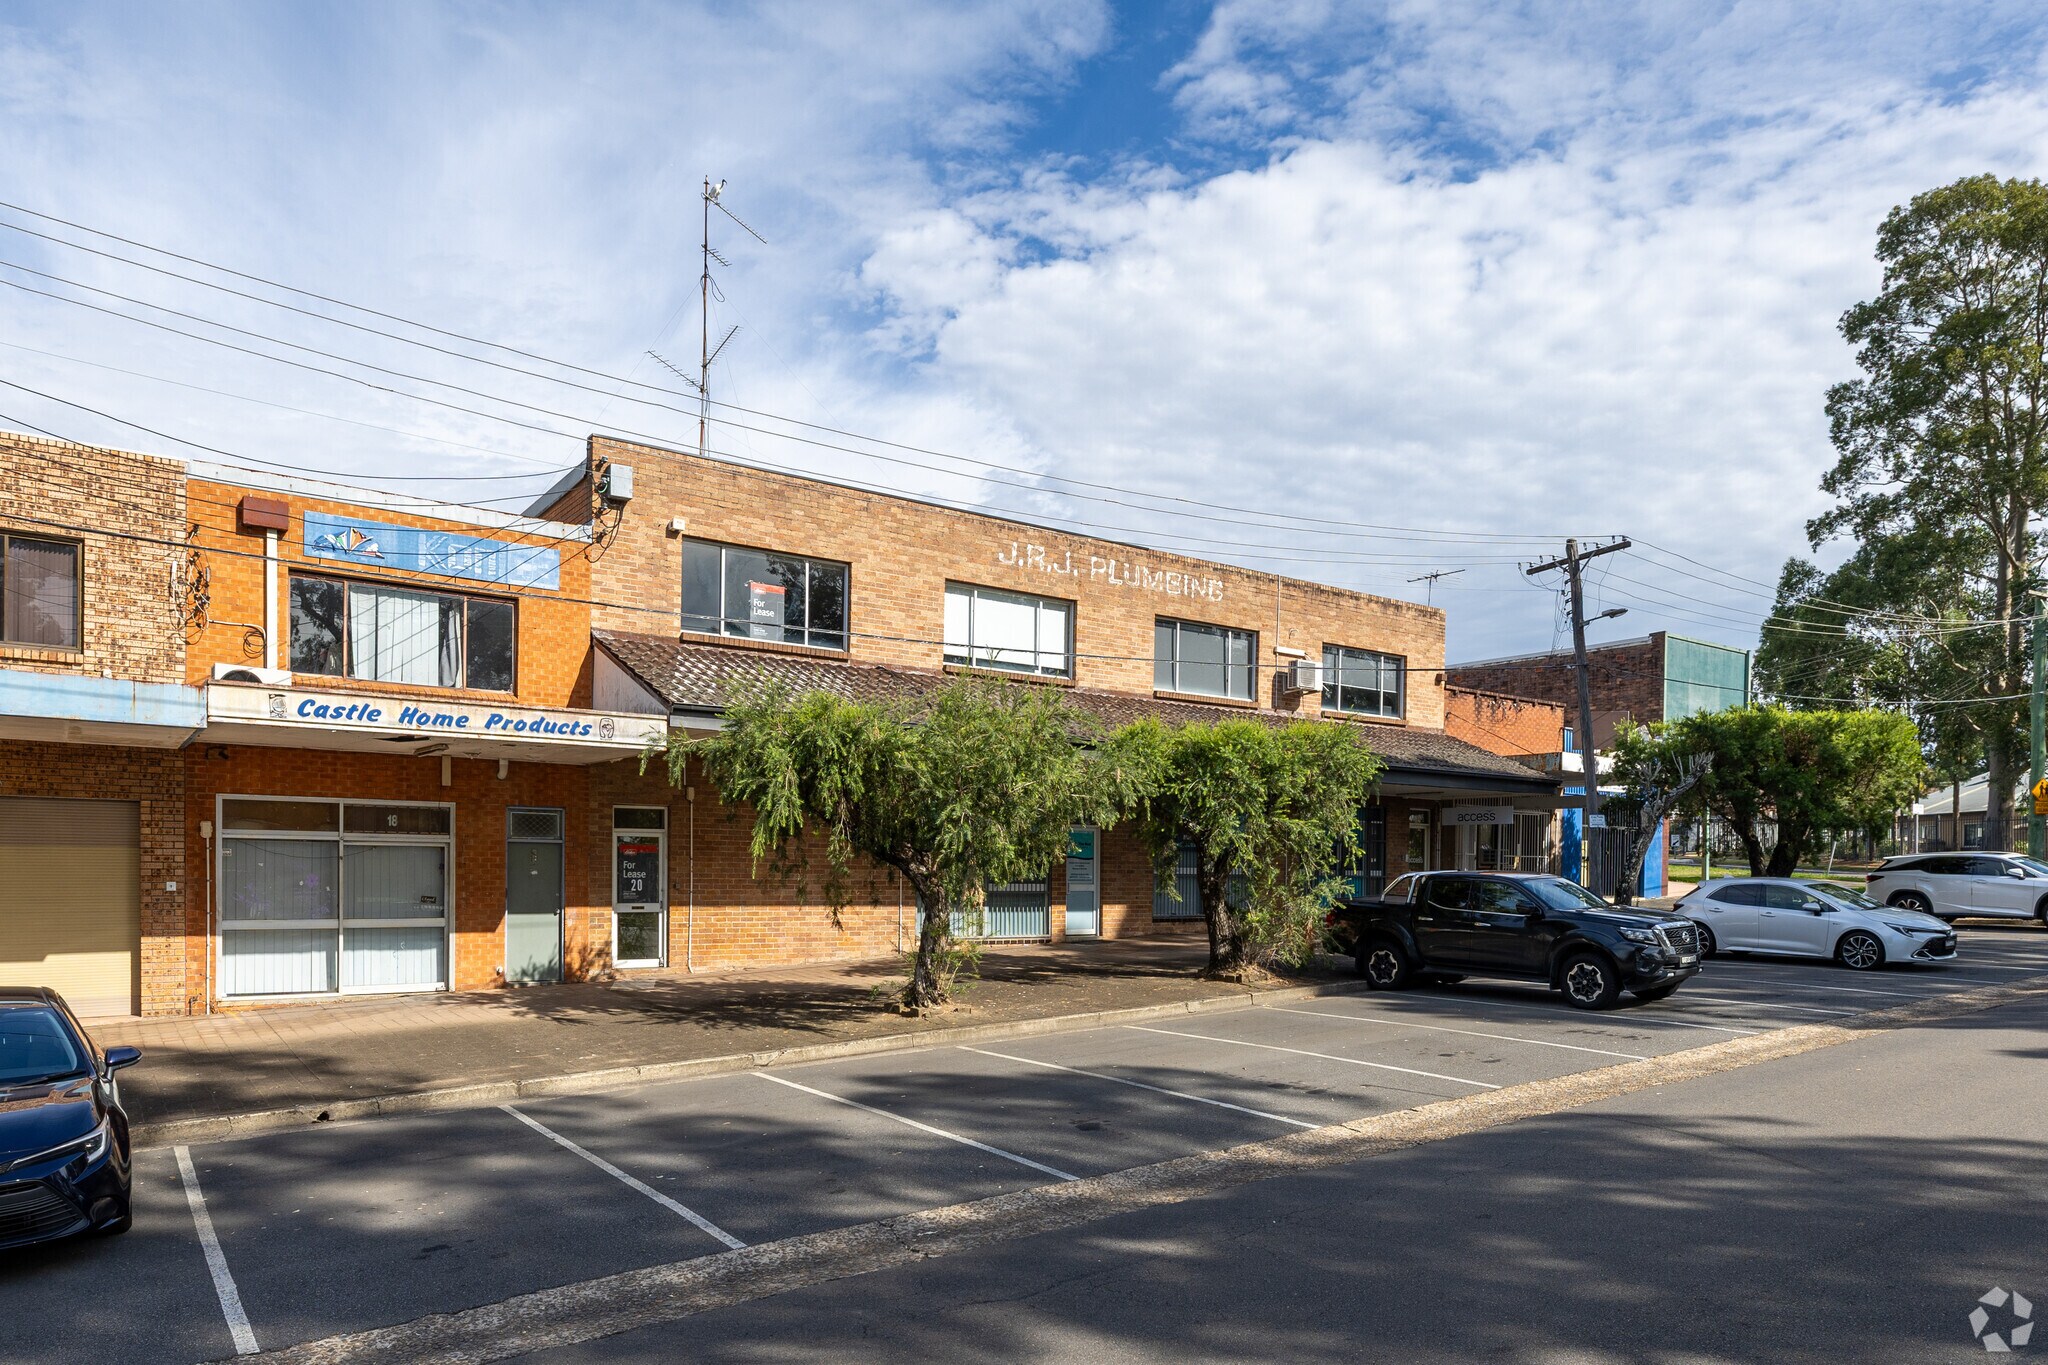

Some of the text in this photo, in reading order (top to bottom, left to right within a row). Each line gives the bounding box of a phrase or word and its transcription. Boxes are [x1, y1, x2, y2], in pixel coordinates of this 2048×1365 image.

[1090, 556, 1224, 602] PLUMBING
[753, 598, 766, 607] For
[753, 607, 775, 618] Lease
[297, 699, 593, 737] Castle Home Products
[387, 814, 398, 827] 18
[1457, 811, 1496, 822] access
[623, 860, 636, 869] For
[623, 869, 647, 878] Lease
[630, 879, 643, 891] 20
